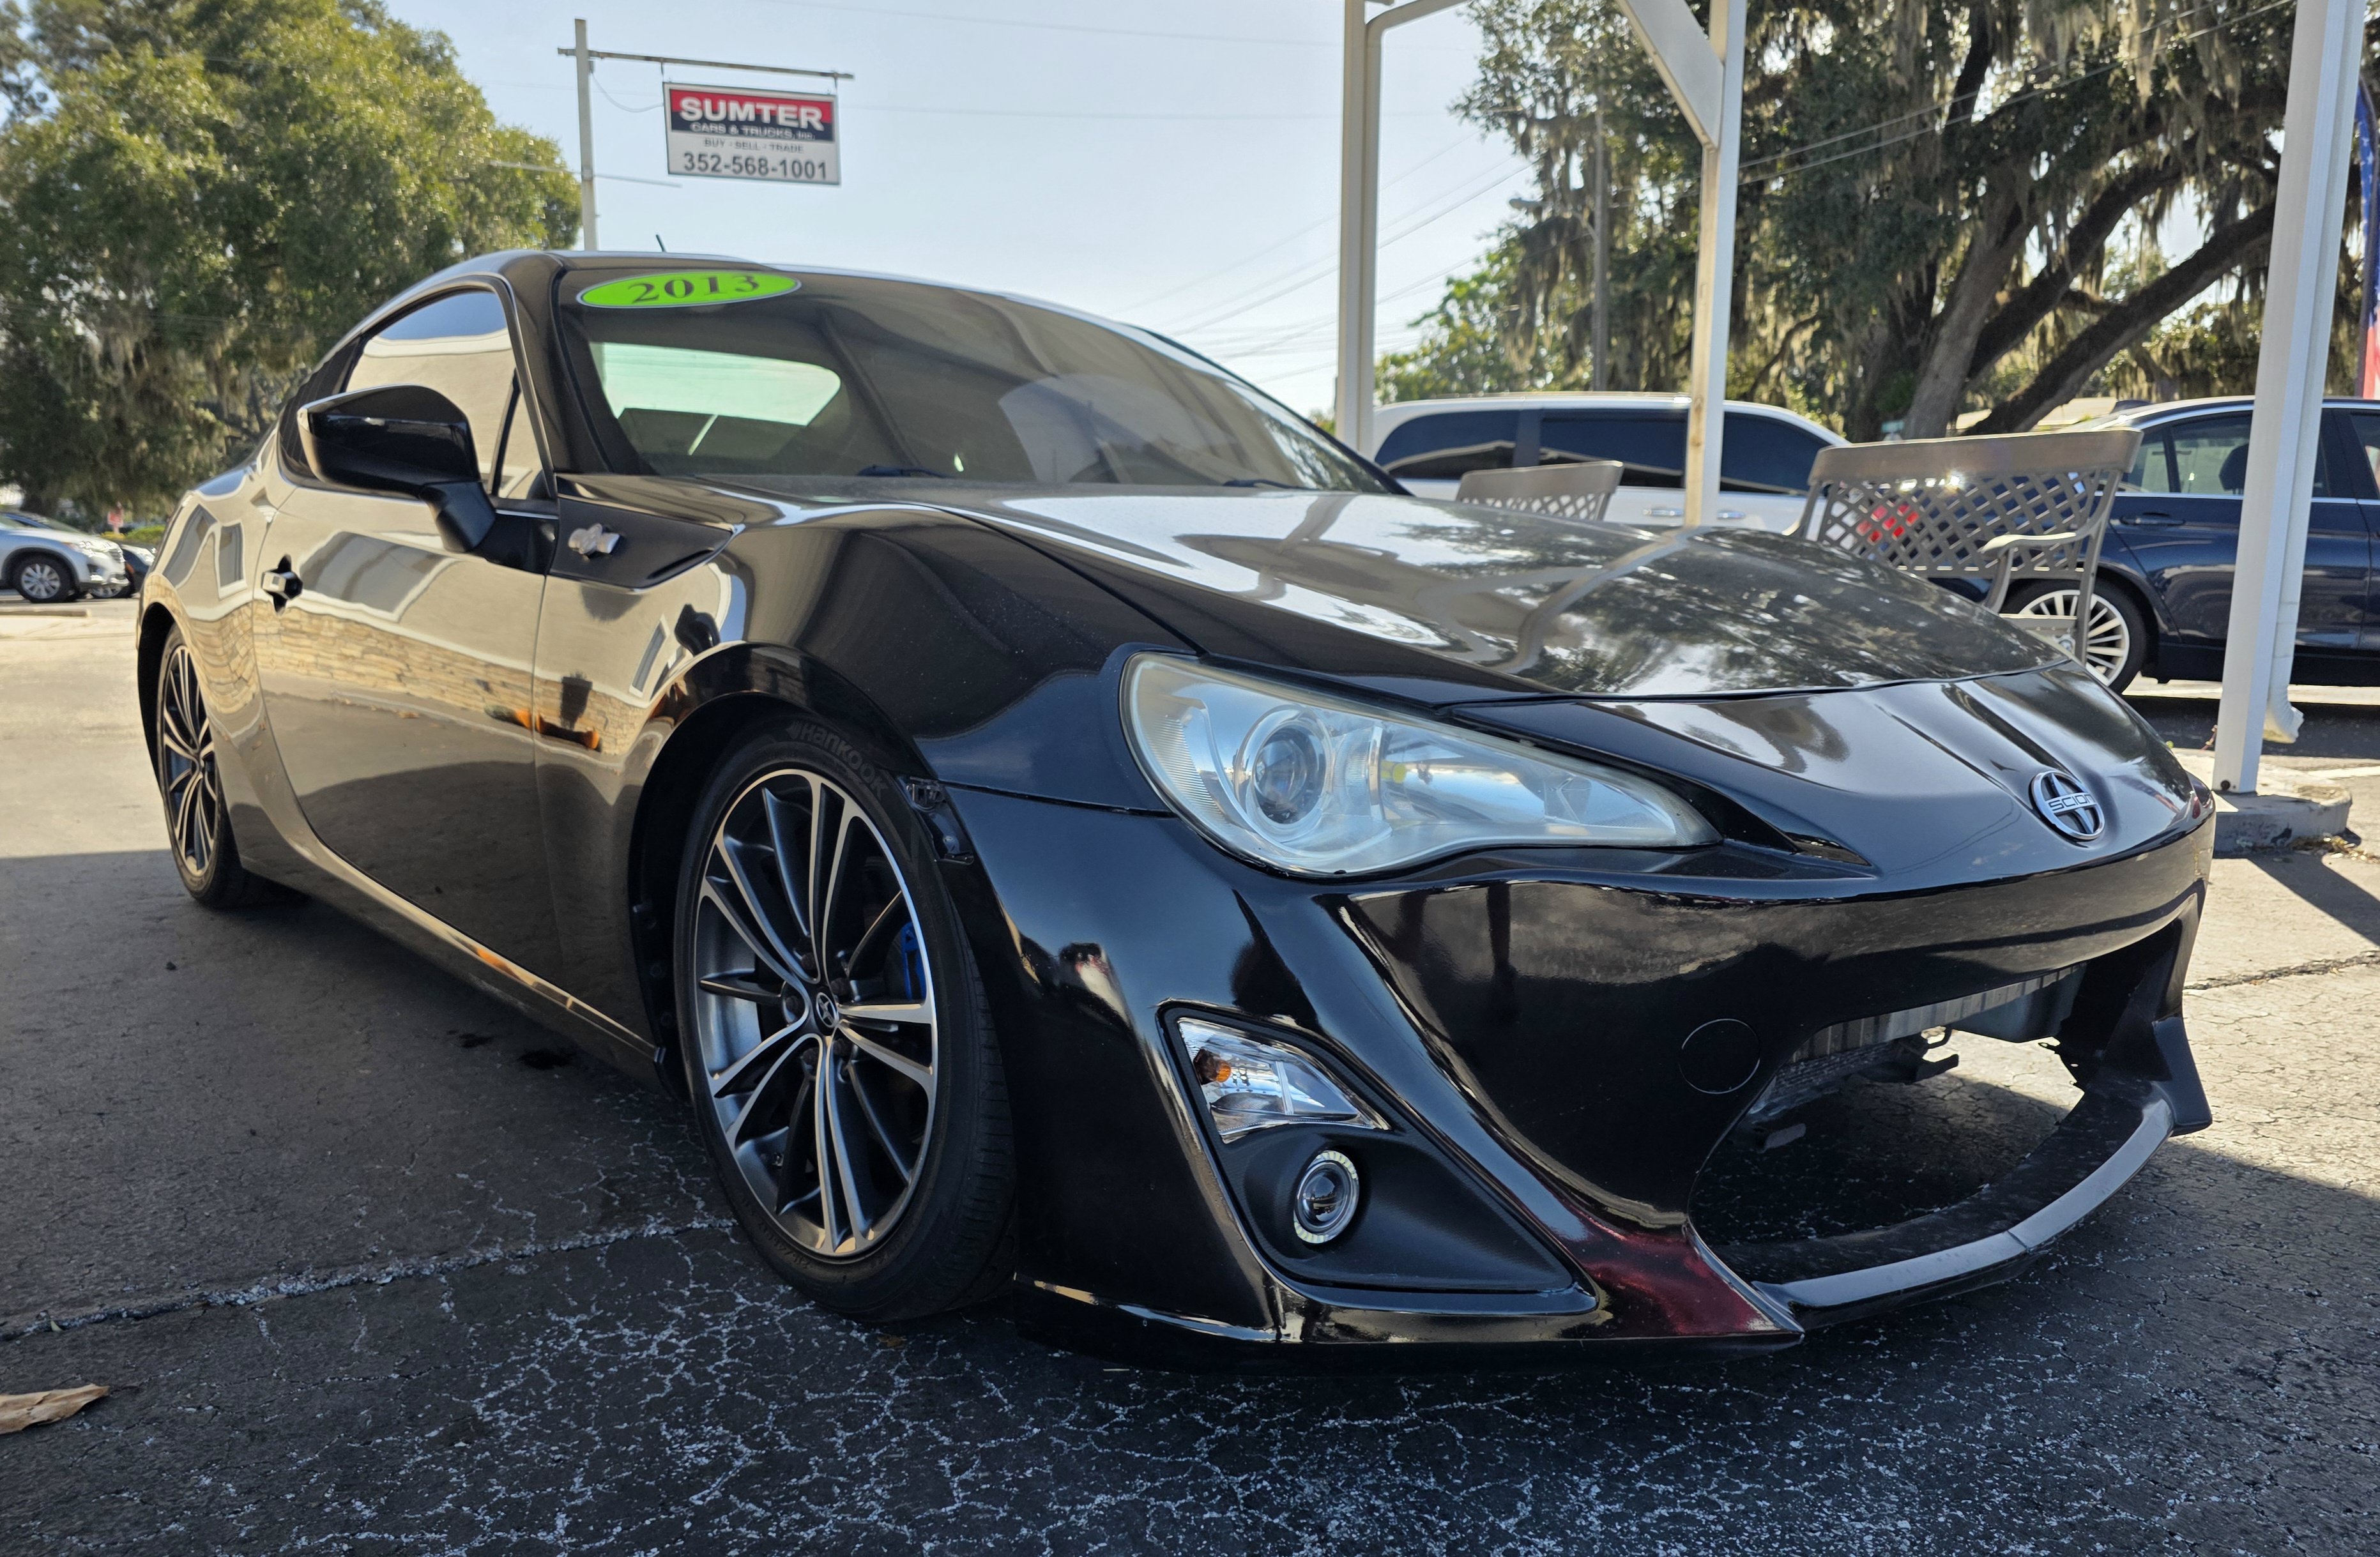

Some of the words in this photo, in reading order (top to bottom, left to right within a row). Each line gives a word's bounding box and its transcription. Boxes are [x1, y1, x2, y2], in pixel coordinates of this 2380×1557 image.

[680, 96, 825, 131] SUMTER
[690, 122, 726, 134] CARS
[729, 124, 739, 135] &
[704, 137, 725, 148] BUY
[735, 140, 761, 151] SELL
[769, 142, 804, 153] TRADE
[683, 151, 827, 179] 352-568-1001
[628, 275, 761, 304] 2013
